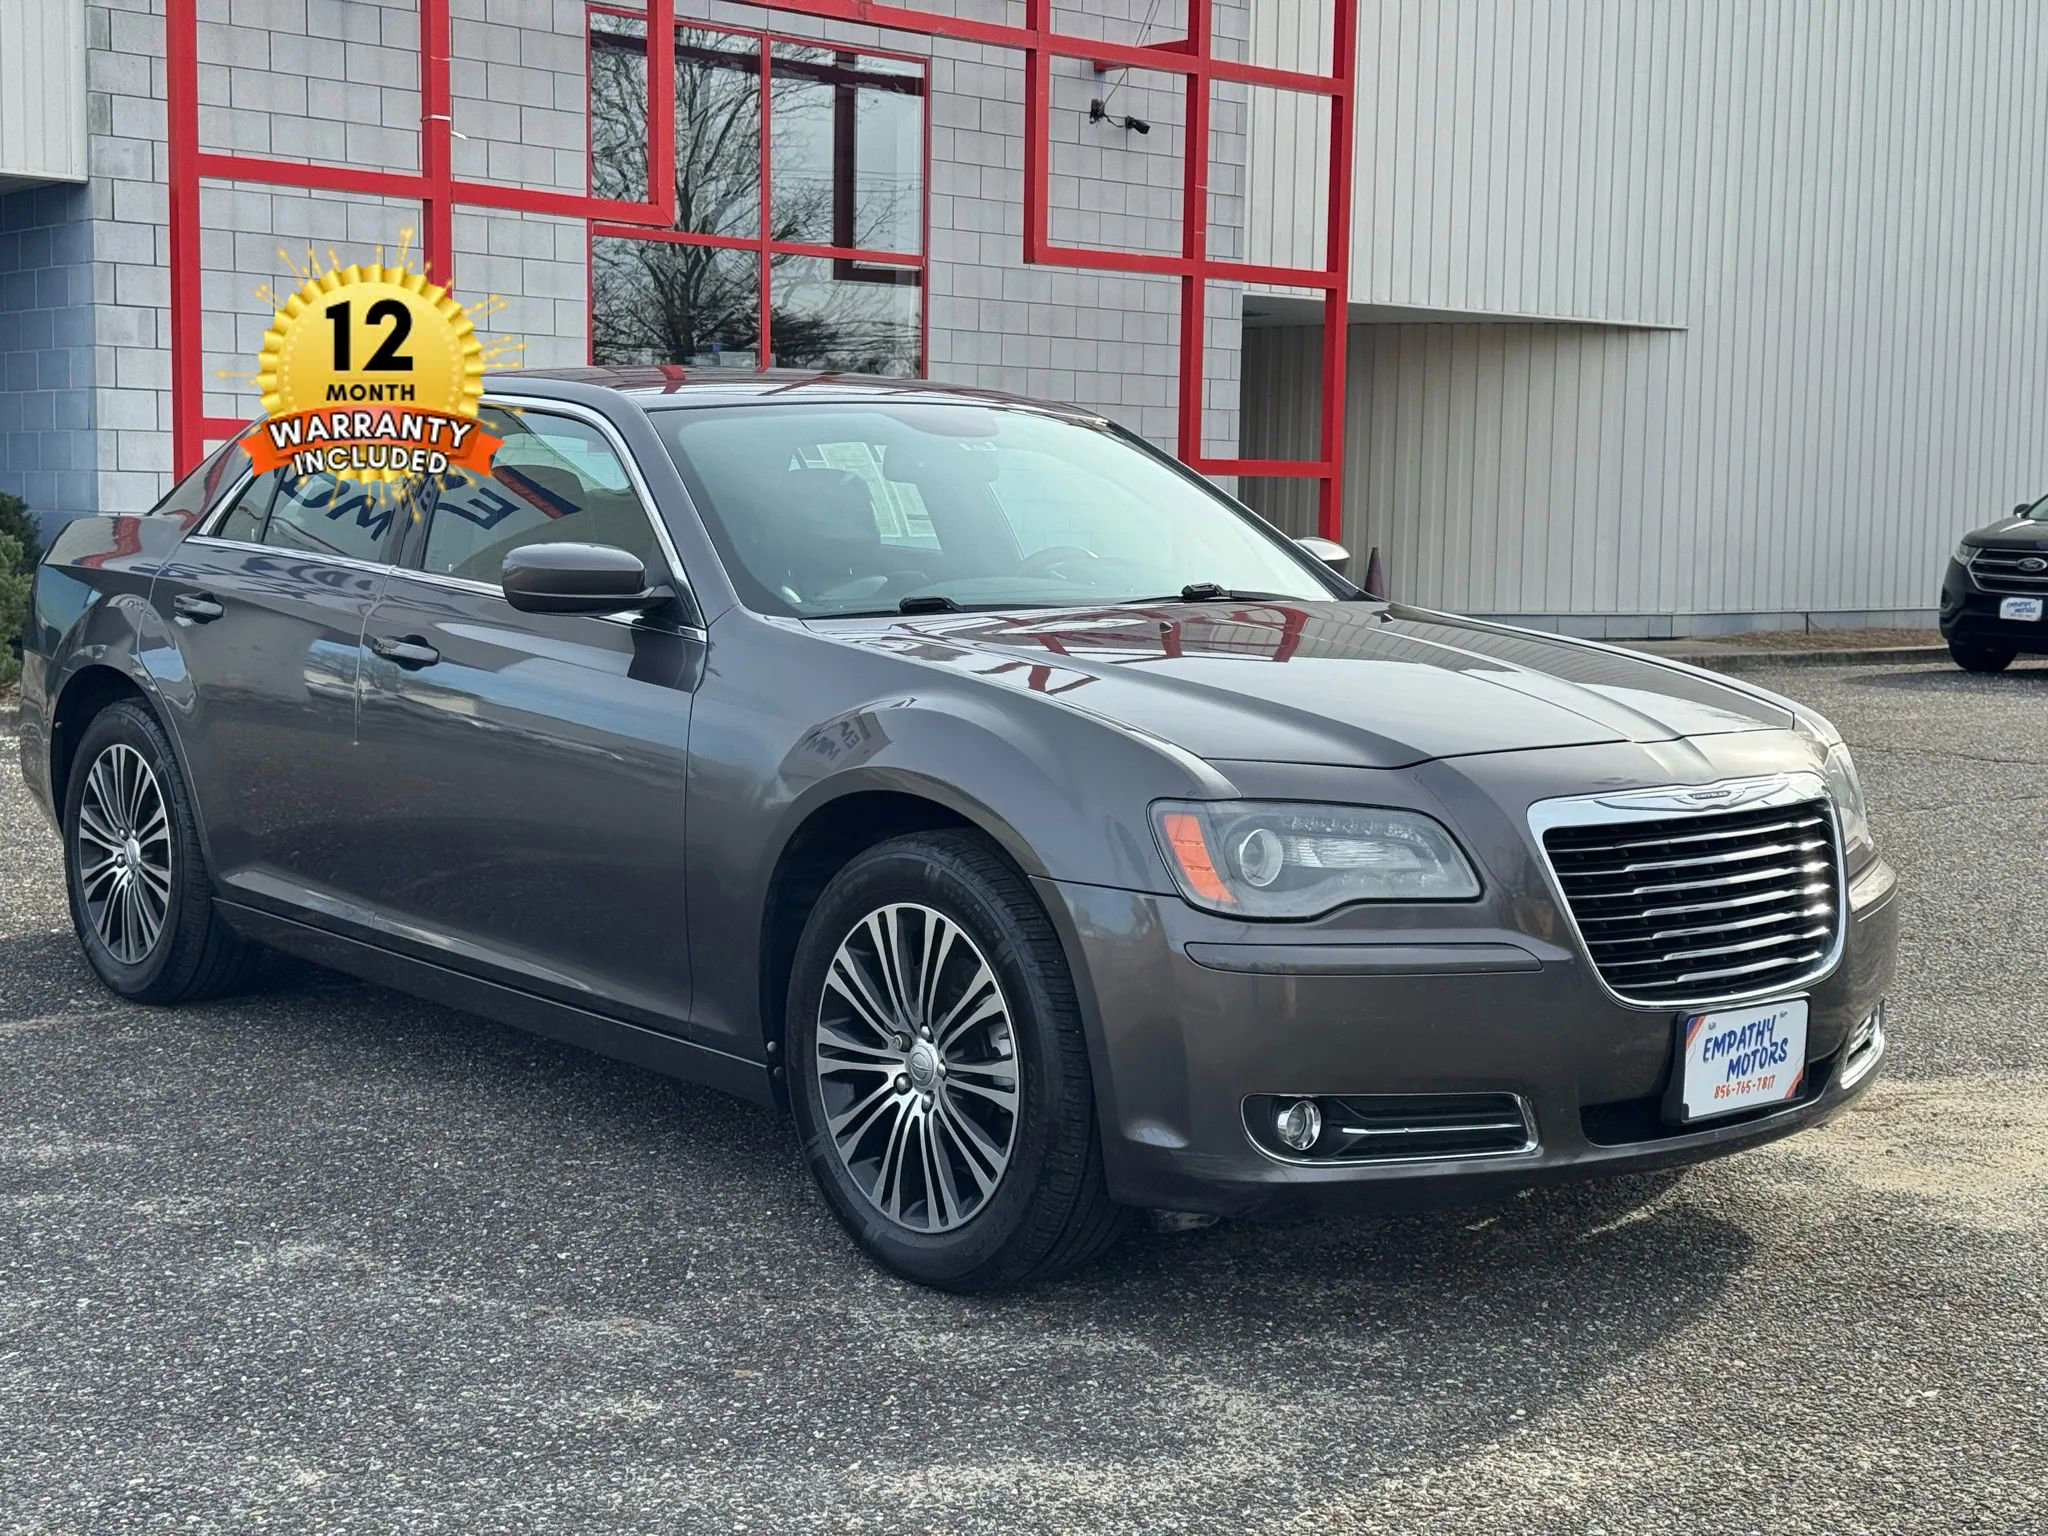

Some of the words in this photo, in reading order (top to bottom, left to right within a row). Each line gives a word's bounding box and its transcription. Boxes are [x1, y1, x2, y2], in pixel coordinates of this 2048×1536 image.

[1703, 1015, 1777, 1063] EMPATHY
[1726, 1037, 1789, 1082] MOTORS
[1714, 1074, 1776, 1099] 856-765-7817
